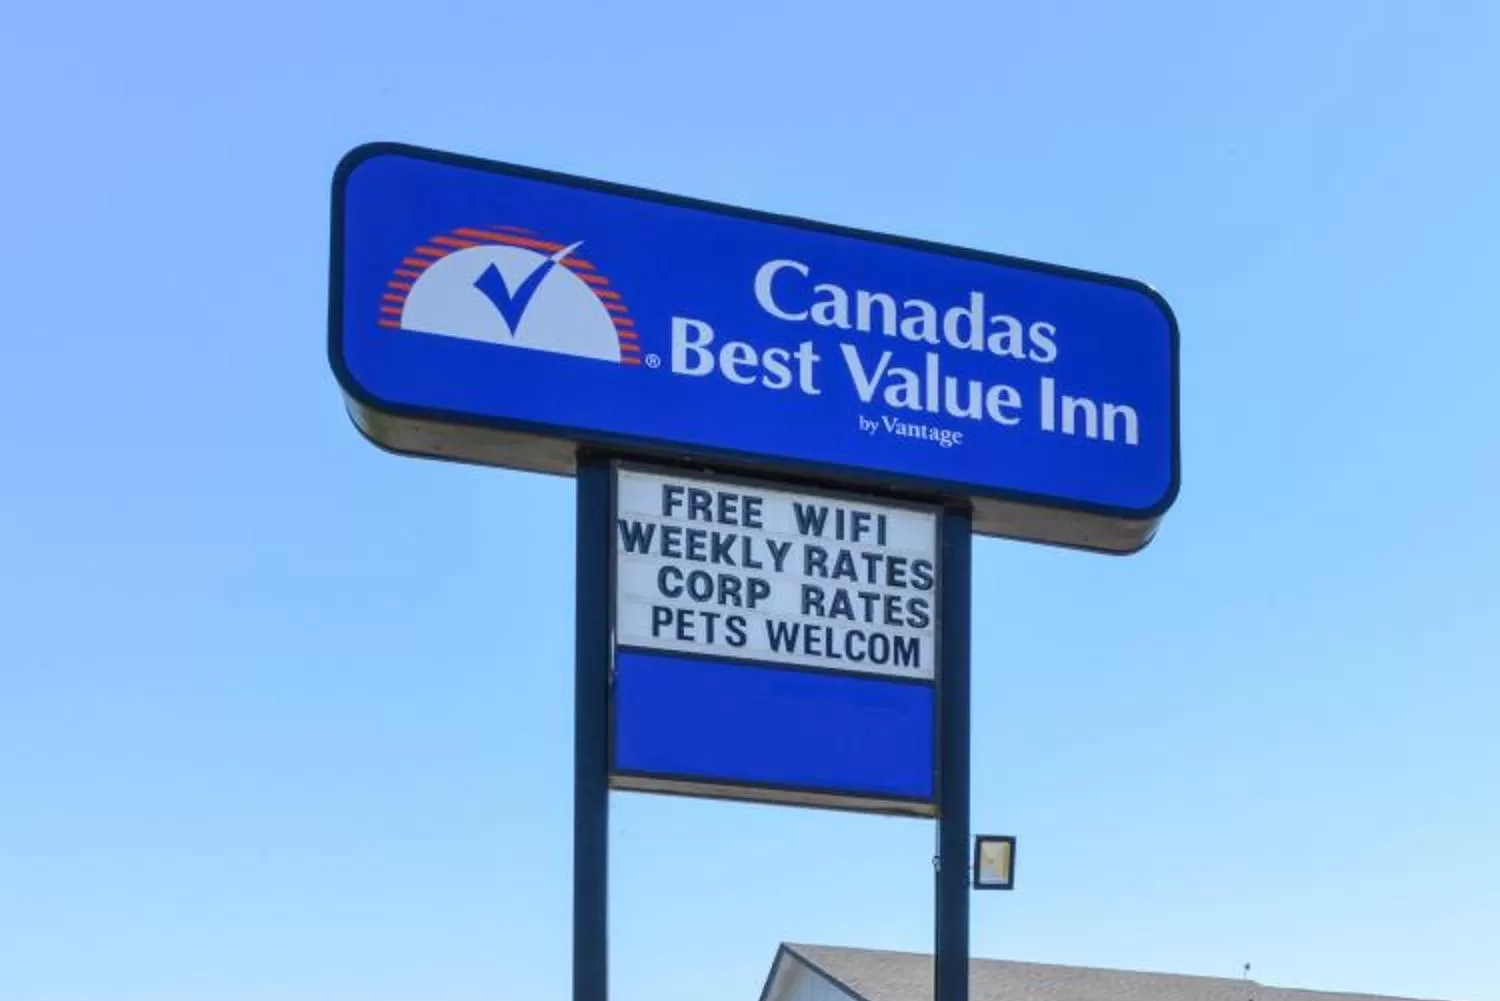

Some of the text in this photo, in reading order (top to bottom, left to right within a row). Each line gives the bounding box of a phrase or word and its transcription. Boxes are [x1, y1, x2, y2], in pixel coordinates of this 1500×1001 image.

[754, 259, 1057, 364] Canadas
[671, 317, 1139, 446] Best Value Inn
[858, 415, 963, 447] by Vantage
[662, 483, 887, 546] FREE WIFI
[618, 518, 933, 591] WEEKLY RATES
[658, 565, 930, 629] CORP RATES
[652, 606, 920, 668] PETS WELCOM
